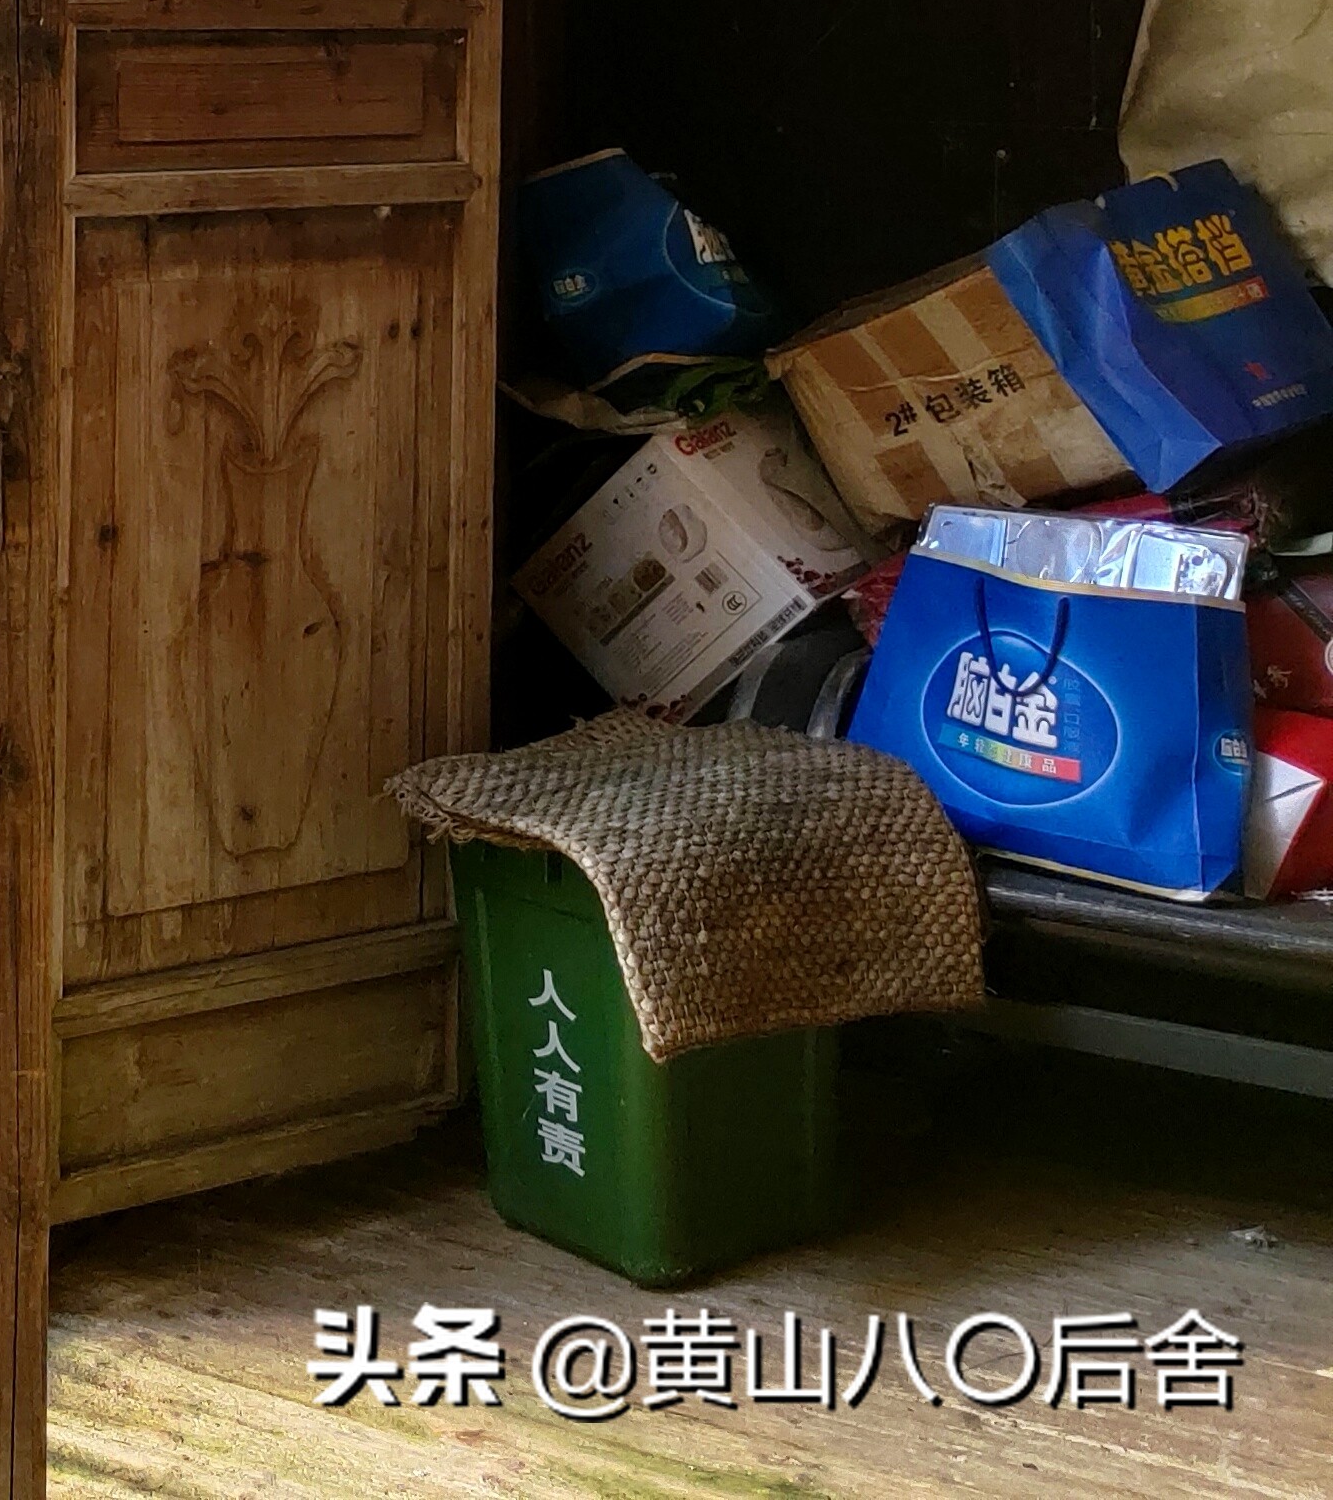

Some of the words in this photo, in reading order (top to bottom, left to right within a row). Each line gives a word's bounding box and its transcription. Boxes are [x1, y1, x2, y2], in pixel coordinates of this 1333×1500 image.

[946, 651, 1058, 749] 脑白金
[528, 968, 586, 1177] 人人有责
